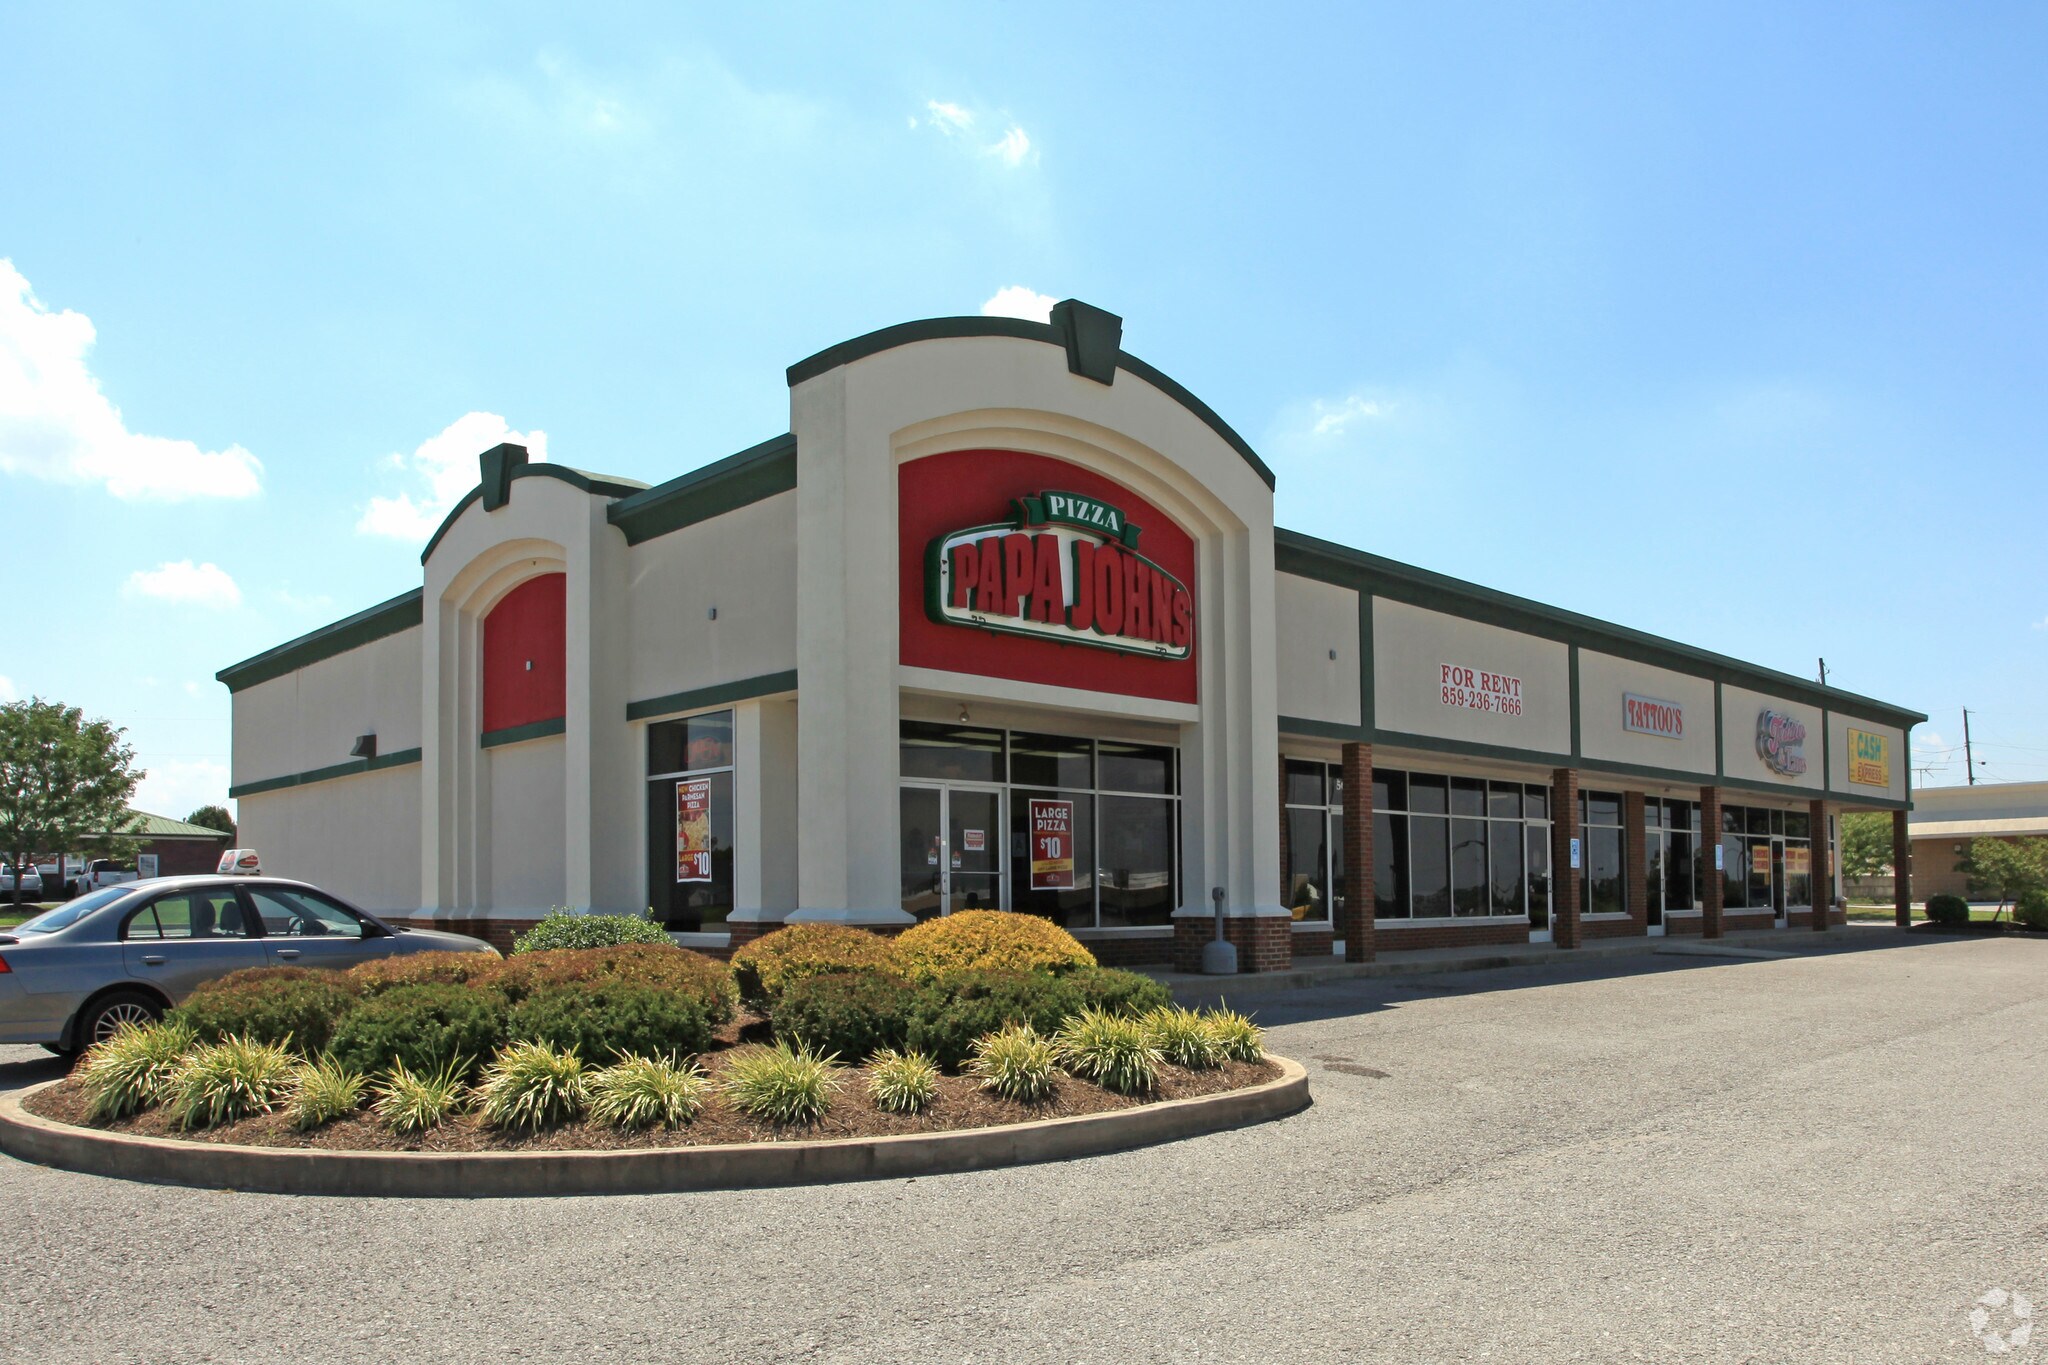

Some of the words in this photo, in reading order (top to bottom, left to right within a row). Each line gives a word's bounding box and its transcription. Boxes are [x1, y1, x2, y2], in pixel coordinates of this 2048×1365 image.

[1049, 494, 1120, 532] PIZZA
[950, 532, 1067, 626] PAPA
[1071, 538, 1191, 648] JOHNS
[1441, 664, 1475, 689] FOR
[1480, 671, 1520, 697] RENT
[1442, 685, 1521, 716] 859-236-7666
[1628, 700, 1682, 734] TATTOO'S
[1857, 732, 1882, 762] CASH
[1857, 761, 1882, 784] EXPRESS
[689, 783, 709, 792] CHICKEN
[1035, 807, 1068, 819] LARGE
[1037, 819, 1067, 831] PIZZA
[1040, 836, 1061, 859] $10
[693, 851, 709, 875] $10
